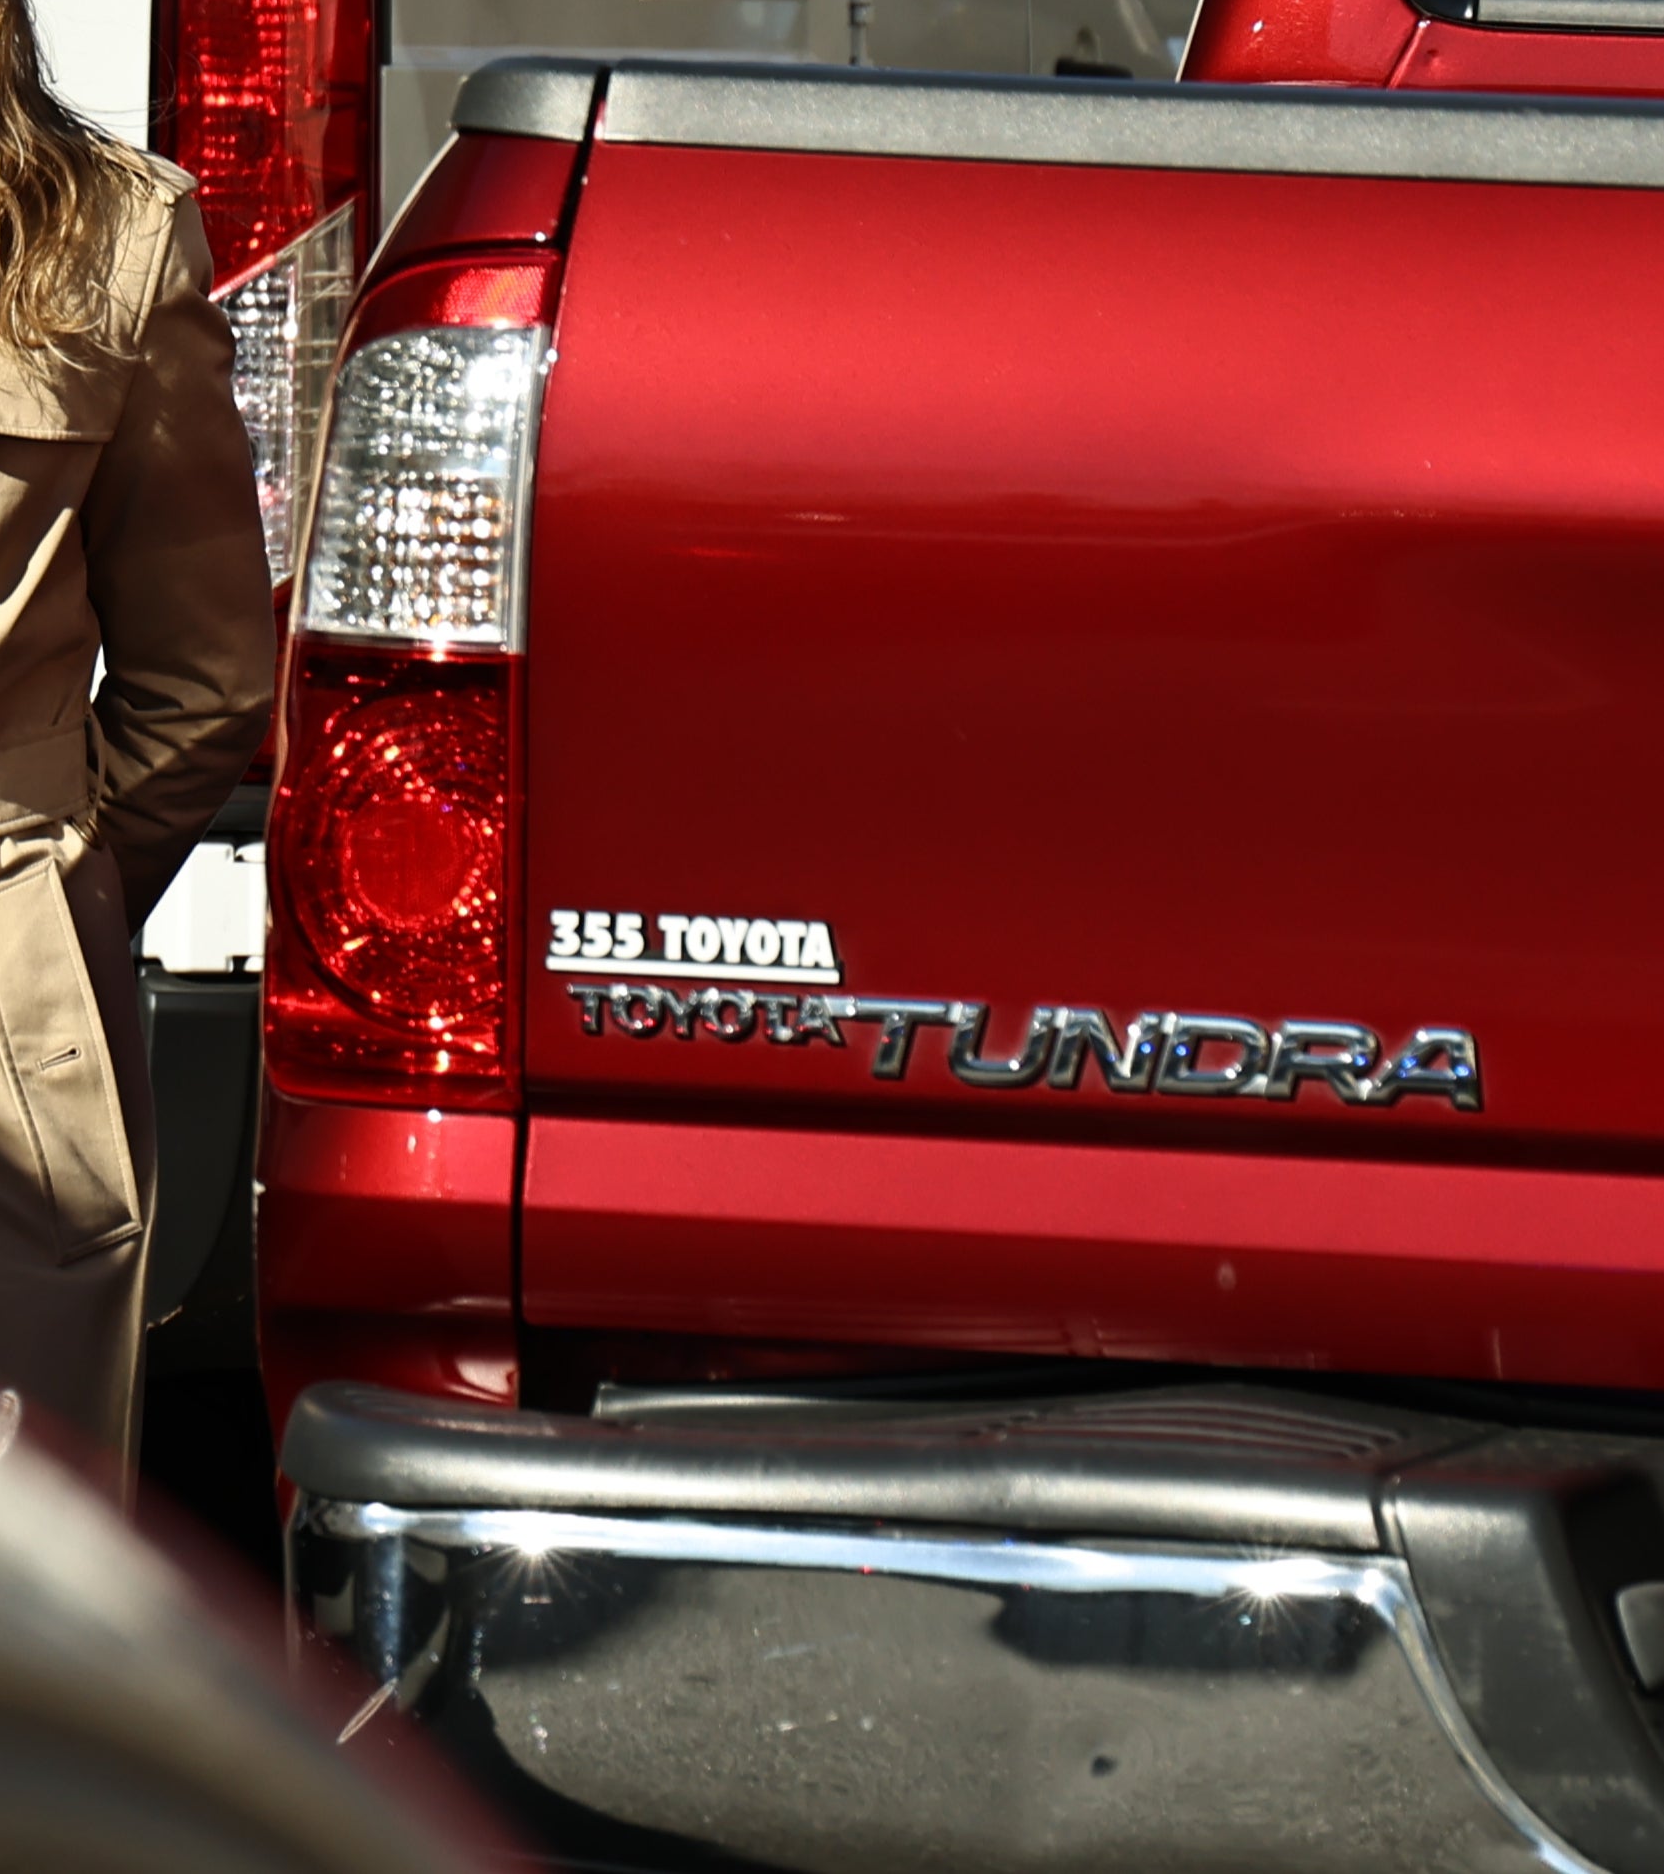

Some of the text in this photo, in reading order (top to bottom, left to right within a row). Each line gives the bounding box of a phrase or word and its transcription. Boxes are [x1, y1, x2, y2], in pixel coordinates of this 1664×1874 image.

[549, 908, 837, 969] 355 TOYOTA
[566, 982, 1484, 1111] TOYOTA TUNDRA
